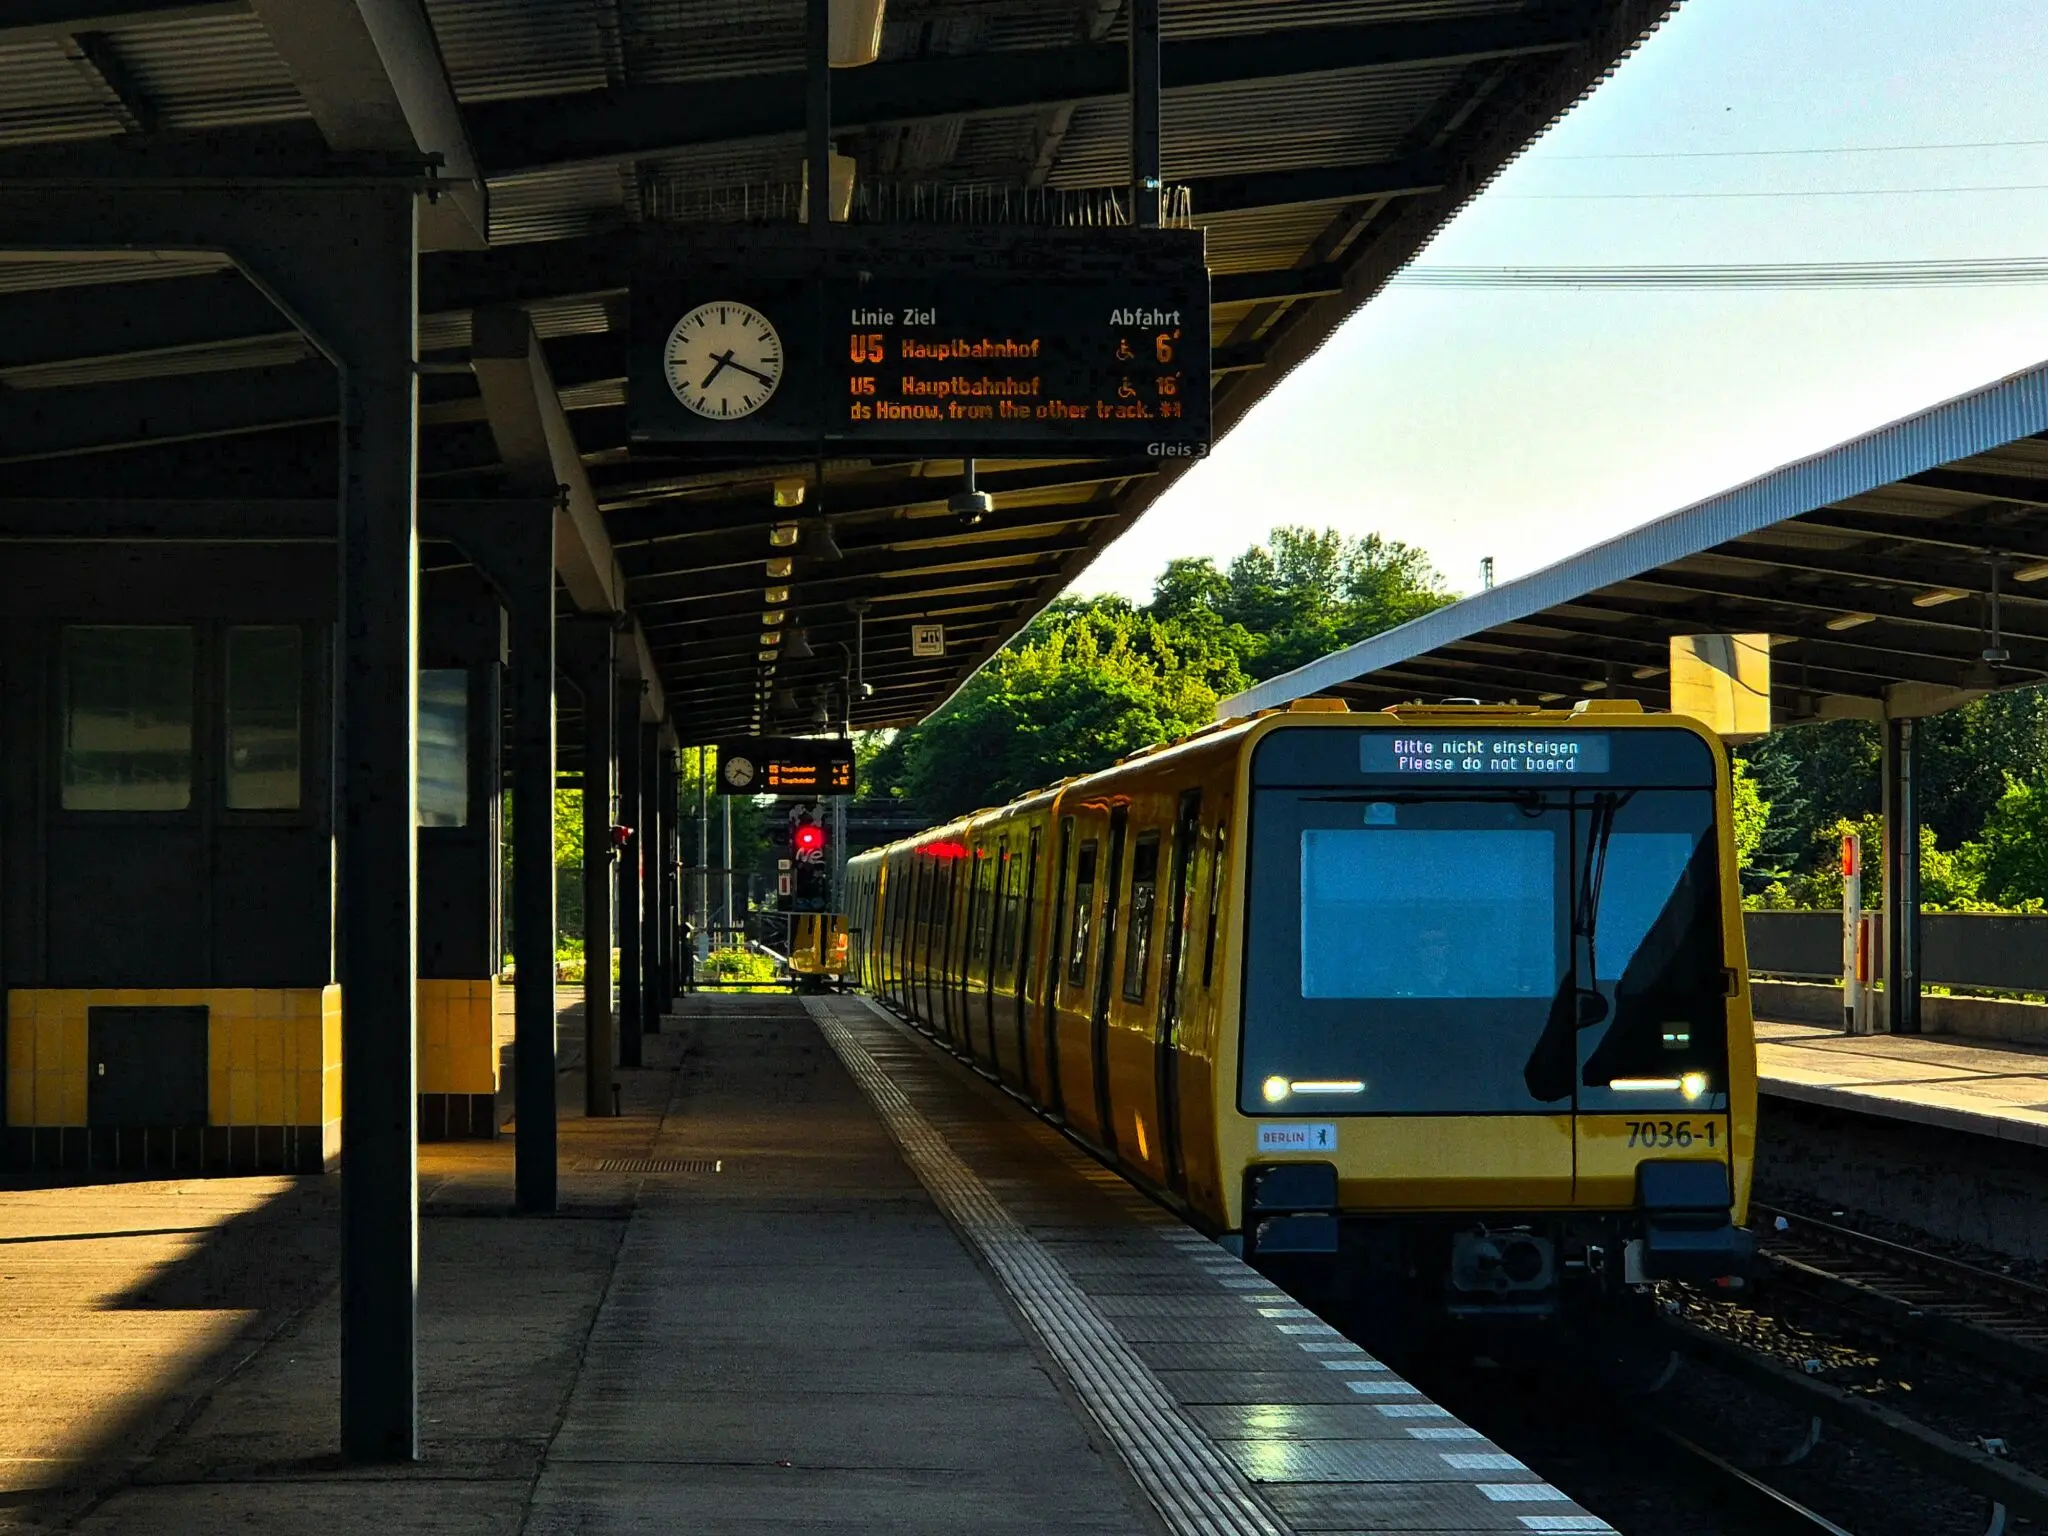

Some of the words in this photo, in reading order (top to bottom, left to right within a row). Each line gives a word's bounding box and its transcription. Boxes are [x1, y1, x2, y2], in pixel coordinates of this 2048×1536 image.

[851, 308, 894, 326] Linie
[902, 307, 936, 326] Ziel
[1109, 308, 1181, 326] Abfahrt
[850, 334, 884, 363] U5
[902, 338, 1040, 361] Hauptbahnhof
[850, 376, 876, 396] U5
[902, 376, 1040, 399] Hauptbahnhof
[850, 401, 872, 420] ds
[876, 400, 944, 421] Hönow,
[948, 400, 993, 420] from
[1000, 400, 1031, 419] the
[1035, 400, 1091, 419] other
[1097, 400, 1154, 419] track.
[1146, 442, 1192, 457] Gleis
[1199, 442, 1208, 457] 3
[1394, 740, 1433, 754] Bitte
[1442, 740, 1484, 754] nicht
[1493, 740, 1579, 756] einsteigen
[1399, 757, 1454, 770] Please
[1462, 757, 1482, 770] do
[1490, 757, 1518, 770] not
[1526, 757, 1575, 770] board
[1263, 1132, 1305, 1143] BERLIN
[1624, 1120, 1716, 1148] 7036-1
